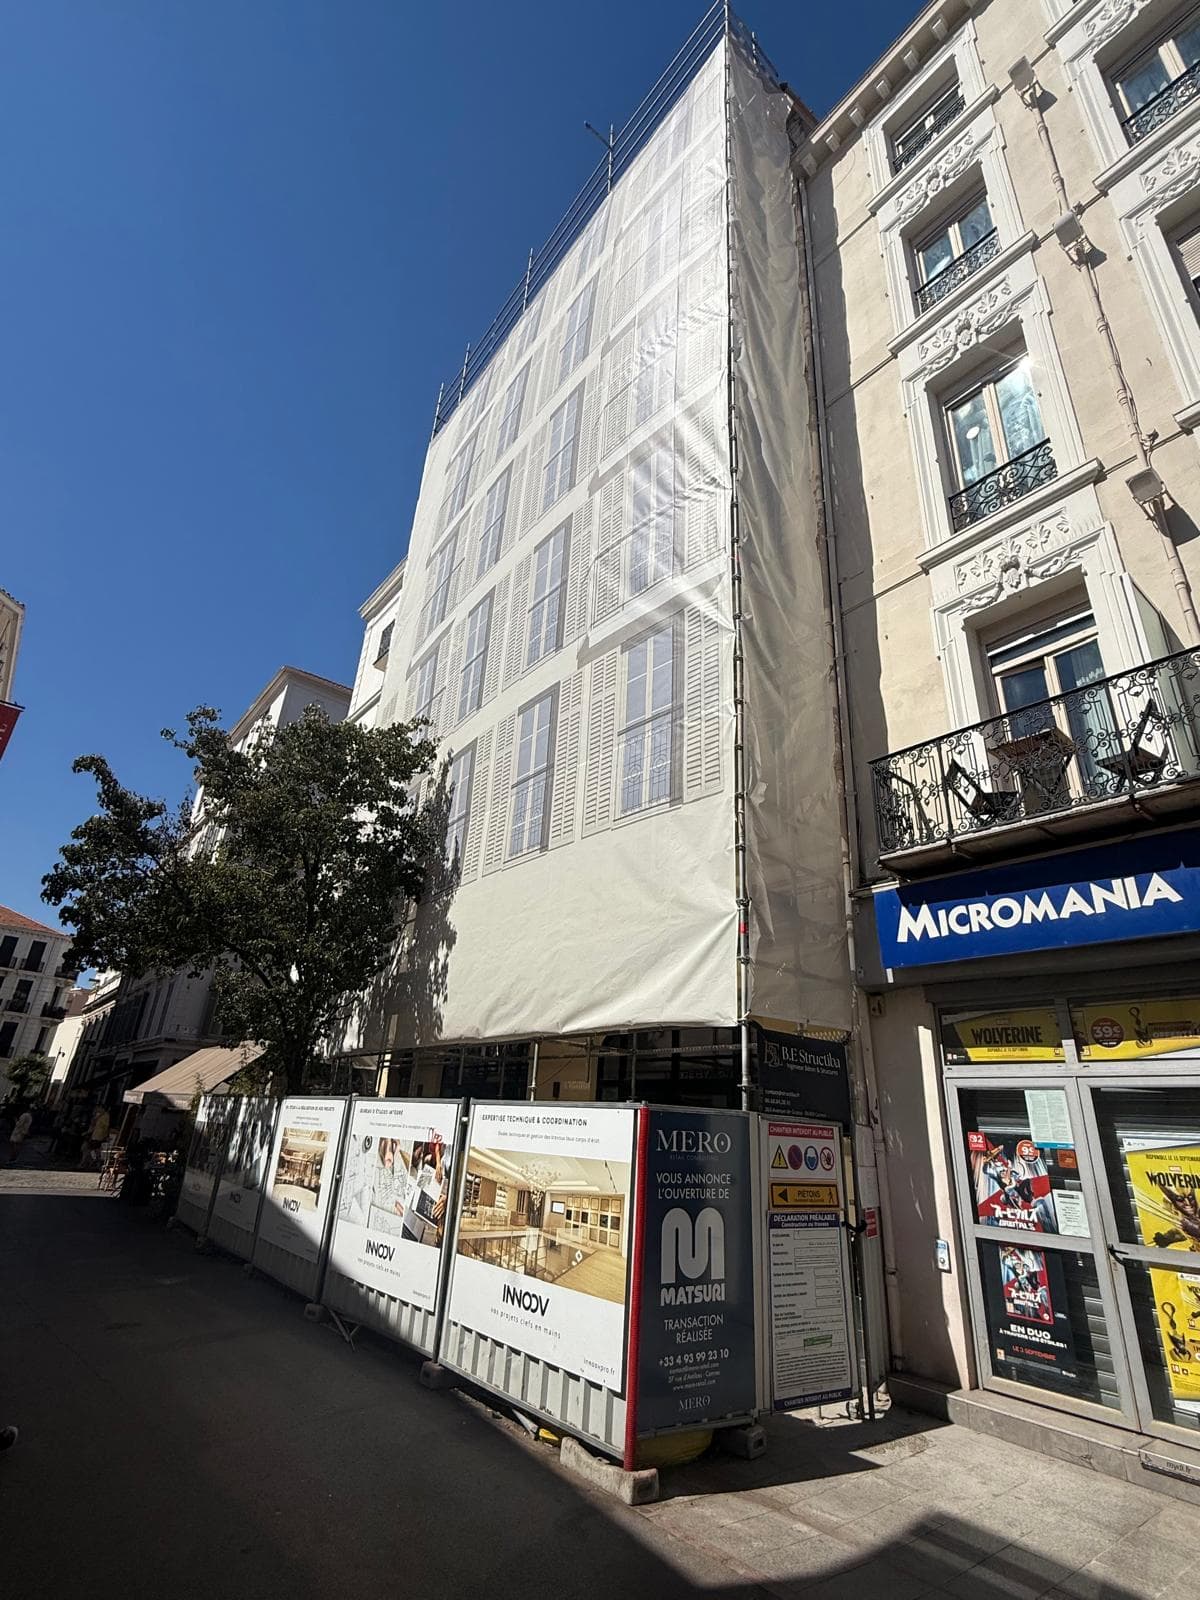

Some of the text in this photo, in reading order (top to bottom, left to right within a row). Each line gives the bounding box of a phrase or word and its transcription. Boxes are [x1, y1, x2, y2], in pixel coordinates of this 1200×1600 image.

[896, 872, 1184, 943] MICROMANIA
[970, 1025, 1043, 1045] WOLVERINE
[482, 1114, 506, 1122] EXPERTISE
[506, 1115, 535, 1124] TECHNIQUE
[542, 1117, 588, 1126] COORDINATION
[656, 1129, 732, 1153] MERO
[656, 1172, 731, 1184] VOUS ANNONCE
[658, 1188, 730, 1199] L'OUVERTURE DE
[773, 1213, 836, 1222] DÉCLARATION PRÉALABLE
[660, 1282, 726, 1307] MATSURI
[500, 1310, 518, 1324] projets
[544, 1327, 561, 1339] mains
[664, 1314, 724, 1331] TRANSACTION
[676, 1326, 713, 1344] RÉALISÉE
[1010, 1324, 1051, 1340] EN DUO
[659, 1348, 729, 1367] +33 4 93 99 23 10
[1024, 1347, 1057, 1360] SEPTEMBRE
[679, 1395, 711, 1410] MERO
